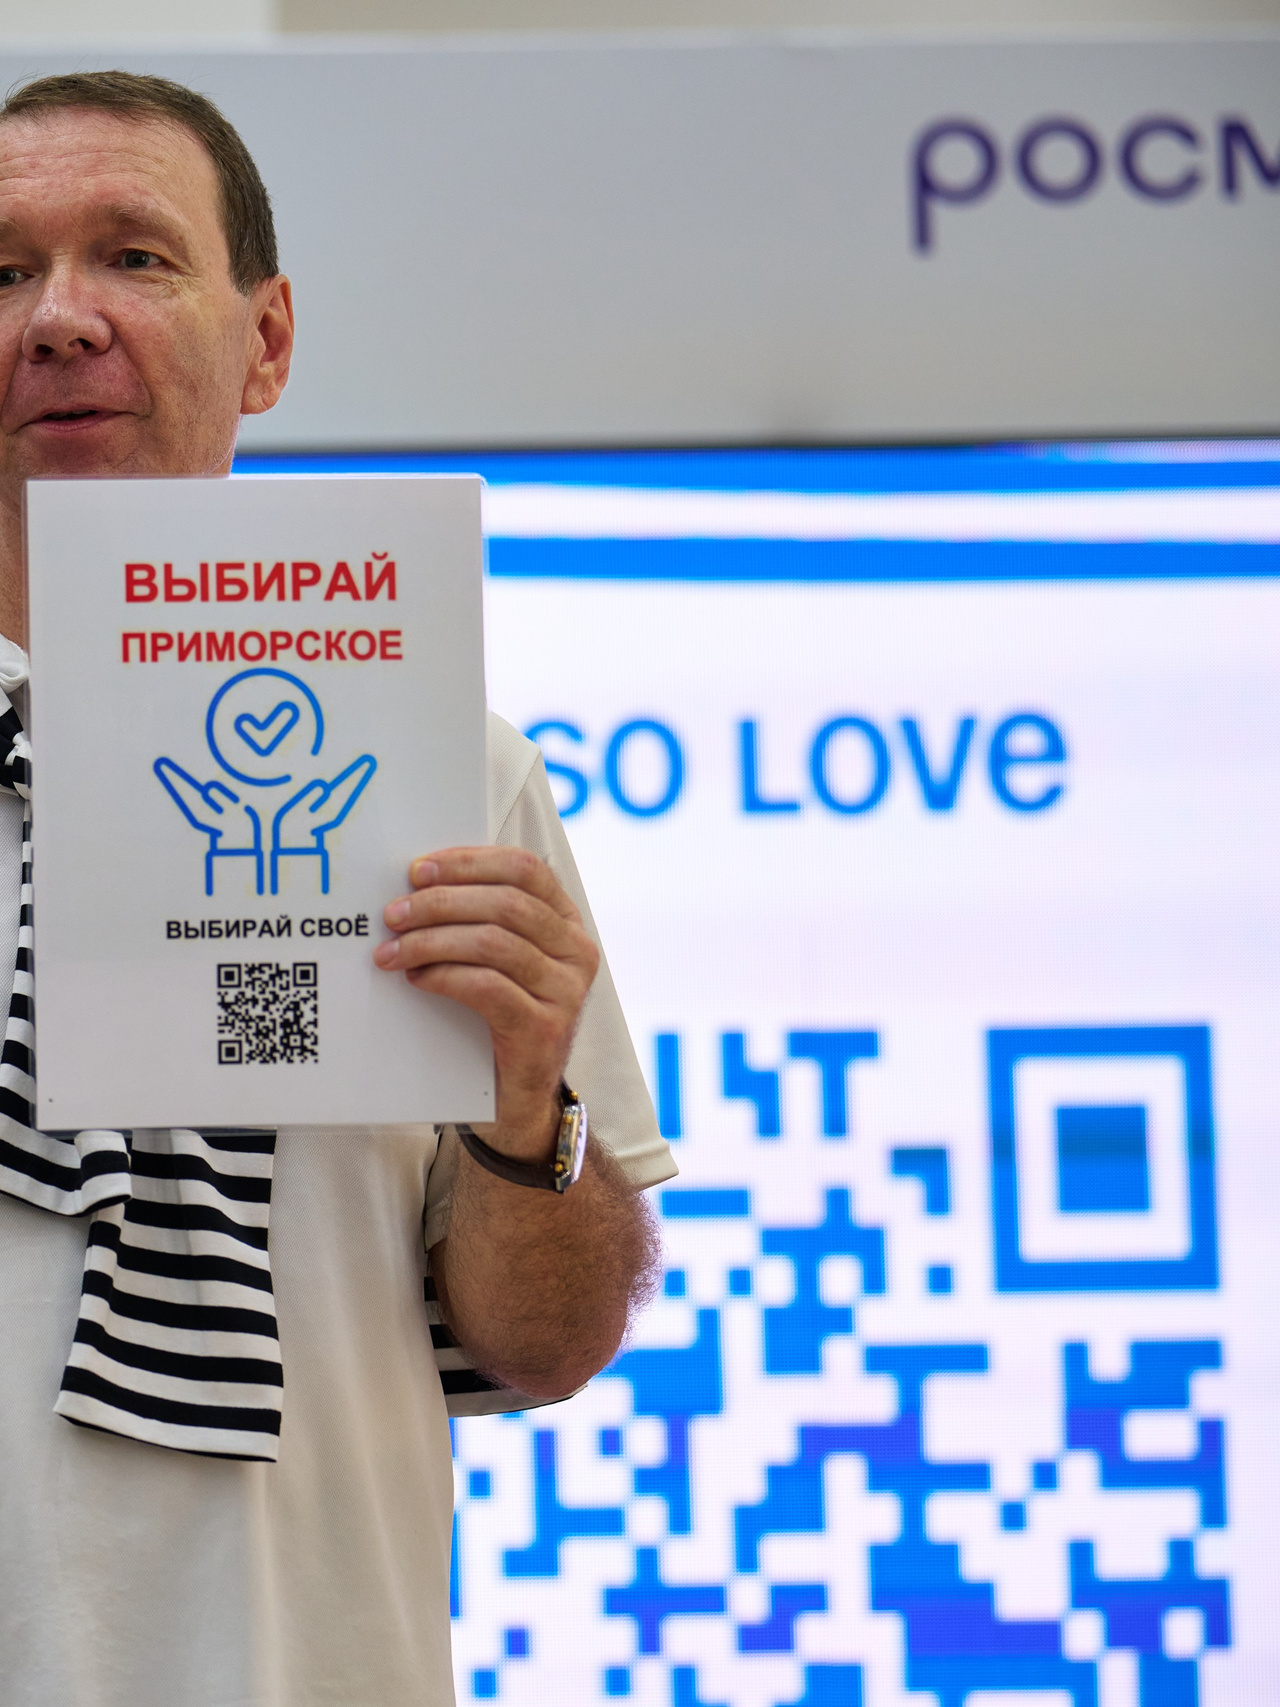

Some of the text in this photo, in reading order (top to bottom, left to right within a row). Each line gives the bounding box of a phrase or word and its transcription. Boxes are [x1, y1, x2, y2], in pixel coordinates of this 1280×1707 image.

[124, 552, 397, 603] ВЫБИРАЙ
[121, 629, 404, 663] ПРИМОРСКОЕ
[166, 914, 369, 939] ВЫБИРАЙ СВОЁ
